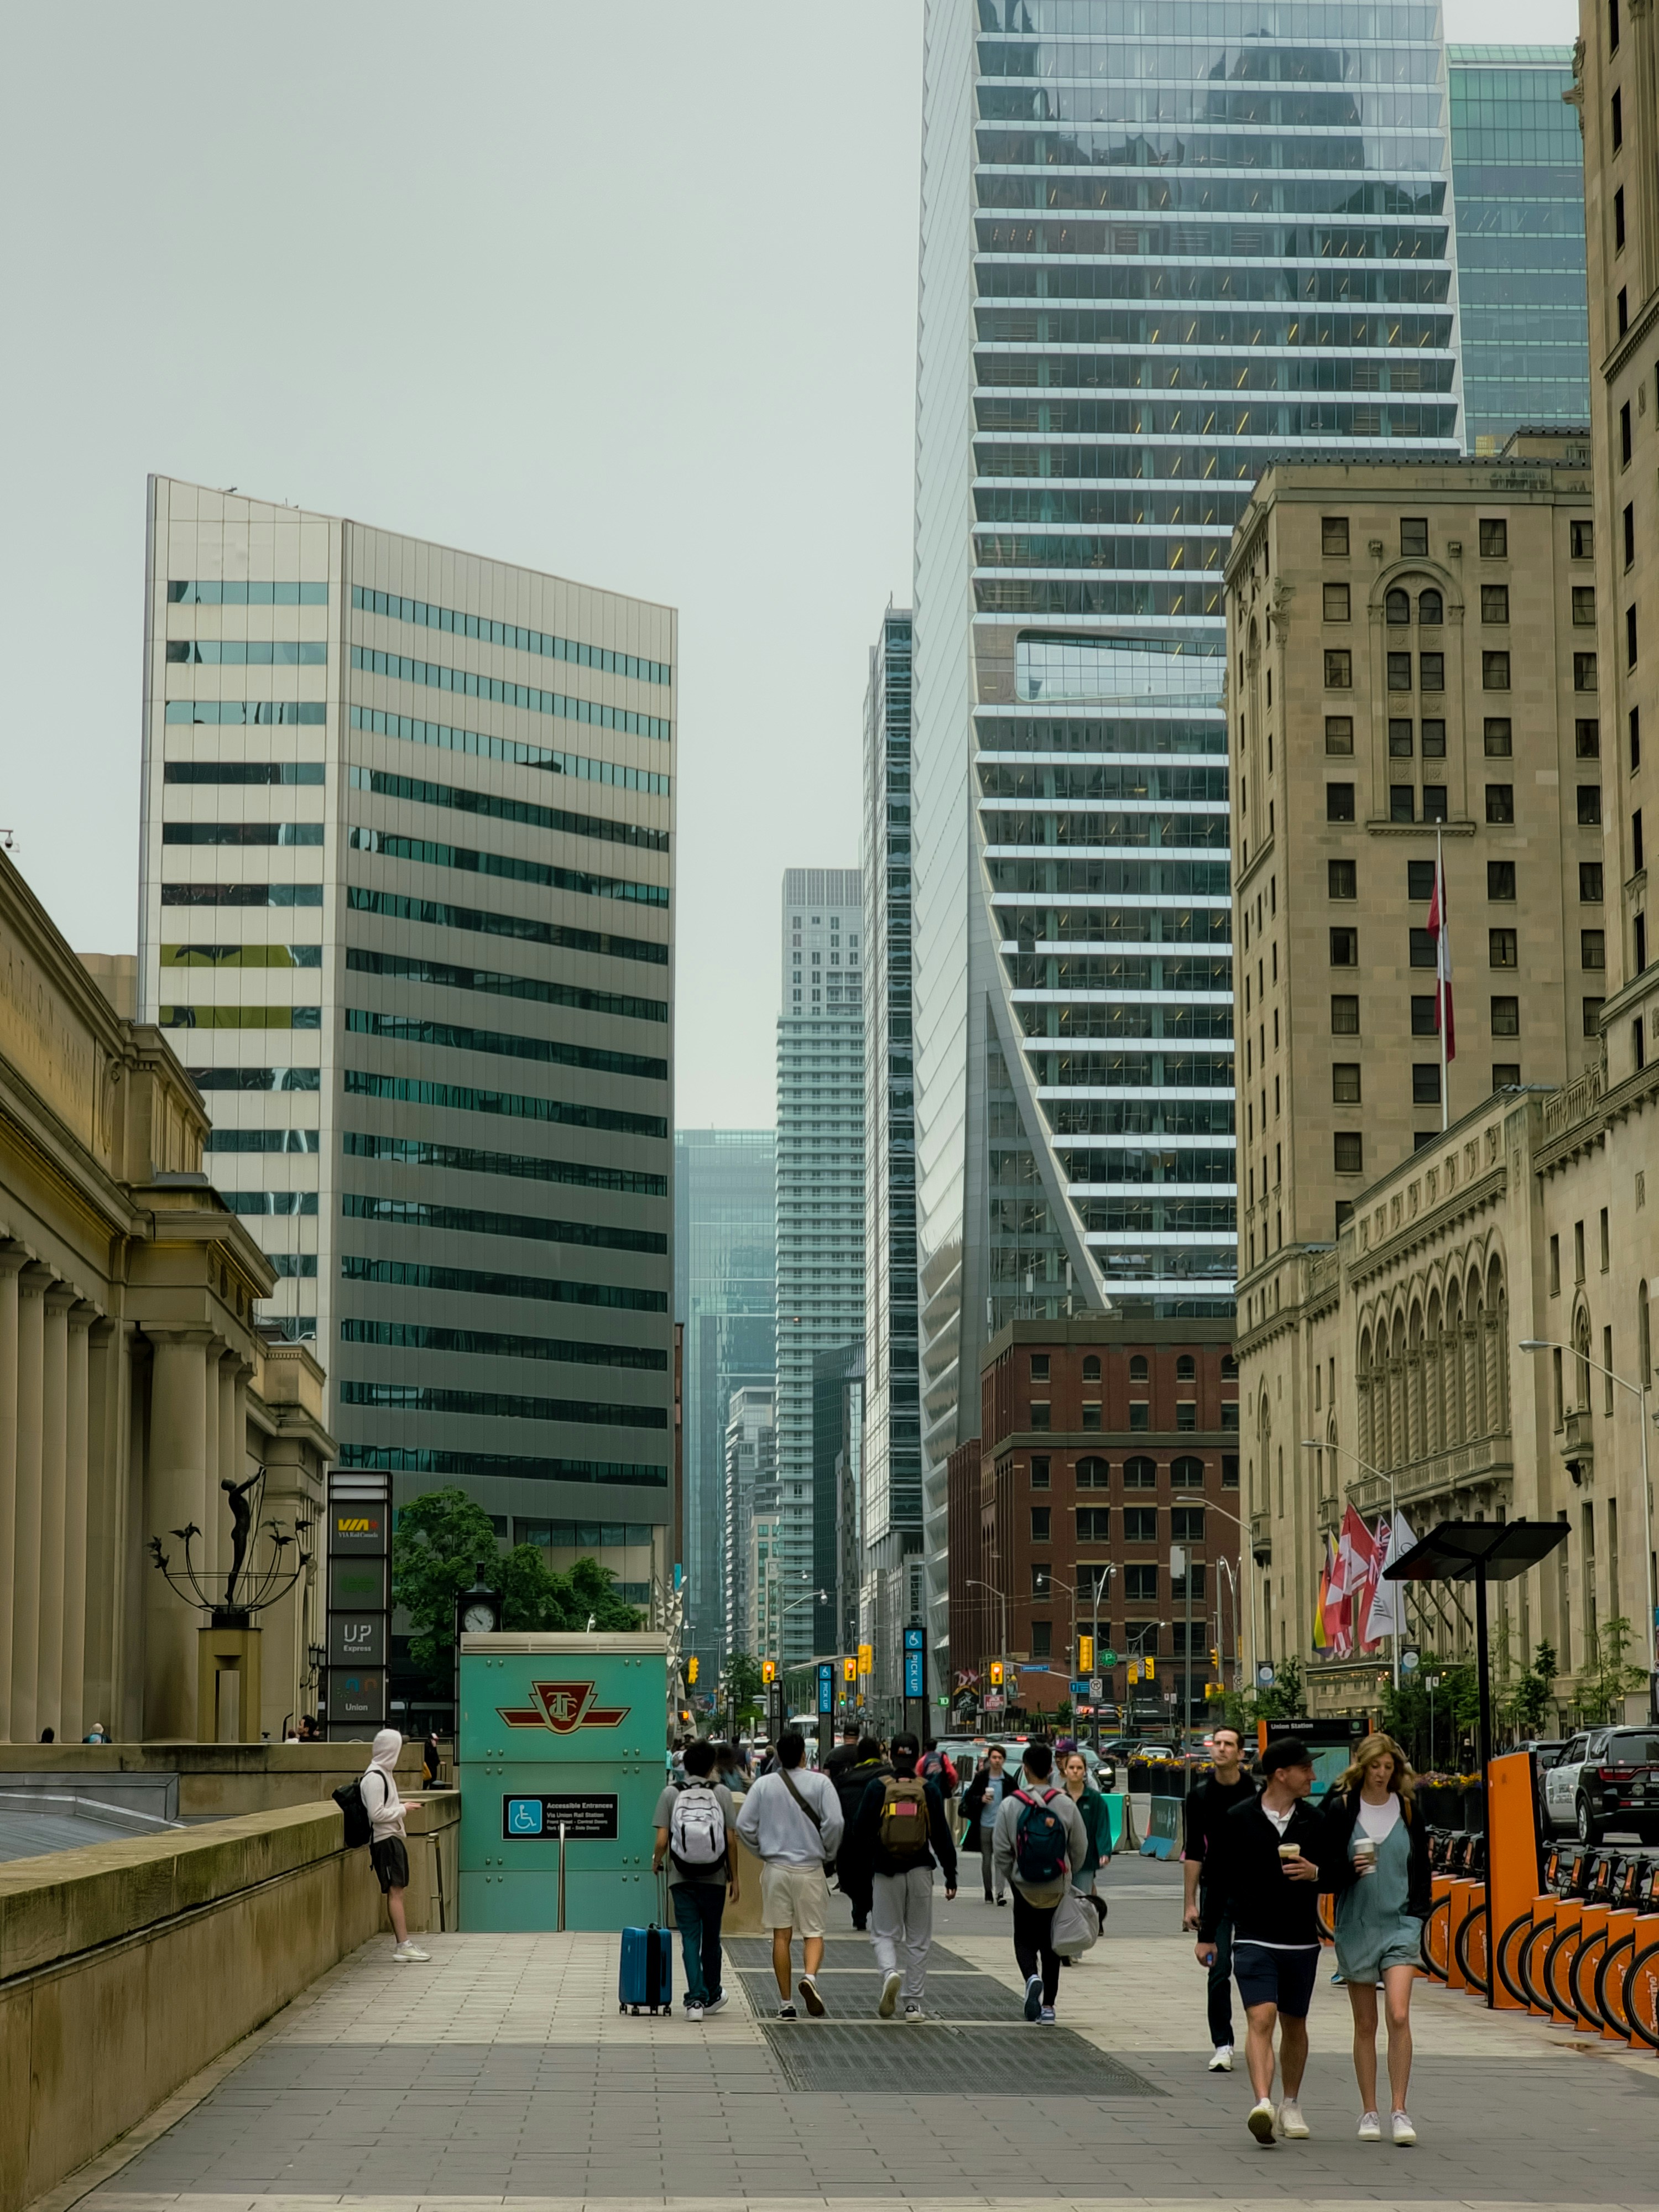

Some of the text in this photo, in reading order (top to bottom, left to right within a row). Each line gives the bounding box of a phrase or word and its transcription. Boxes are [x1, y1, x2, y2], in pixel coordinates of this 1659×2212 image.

[338, 1519, 369, 1531] VIA
[345, 1624, 372, 1642] UP
[911, 1679, 918, 1691] UP
